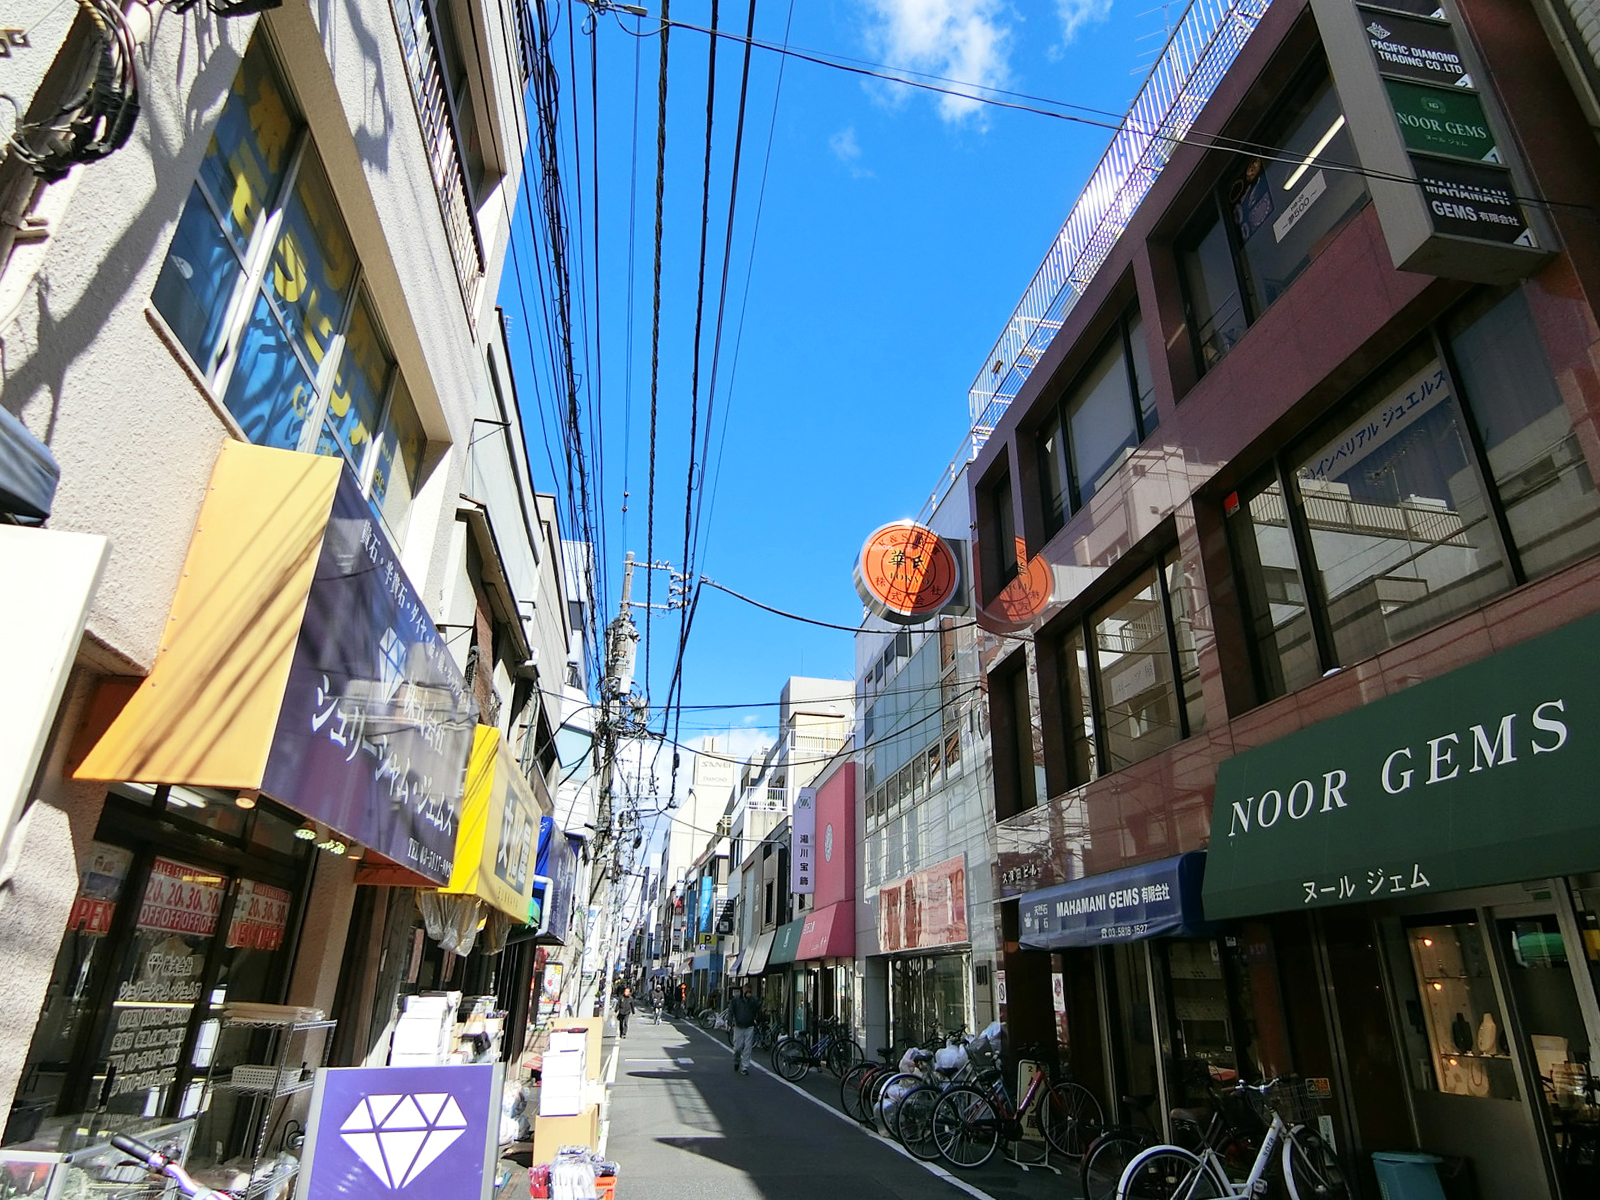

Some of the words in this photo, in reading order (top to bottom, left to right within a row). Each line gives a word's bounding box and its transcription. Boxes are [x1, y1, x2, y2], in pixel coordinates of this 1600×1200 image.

[1371, 39, 1409, 55] PACIFIC
[1410, 47, 1459, 64] DIAMOND
[1378, 50, 1423, 68] TRADING
[1397, 112, 1441, 132] NOOR
[1445, 122, 1487, 139] GEMS
[1432, 200, 1478, 222] GEMS
[1478, 211, 1519, 227] 有限会社
[1382, 369, 1446, 428] ジュエルス
[1228, 769, 1348, 837] NOOR
[1382, 699, 1569, 795] GEMS
[408, 837, 420, 862] TEL
[154, 862, 171, 876] SALE
[1056, 894, 1106, 918] MAHAMANI
[1108, 888, 1140, 910] GEMS
[1141, 883, 1170, 904] 有限会社
[66, 898, 116, 934] PEN
[140, 905, 162, 925] OFF
[161, 909, 180, 928] OFF
[182, 912, 200, 932] OFF
[255, 926, 285, 951] OPEN
[704, 934, 712, 944] P
